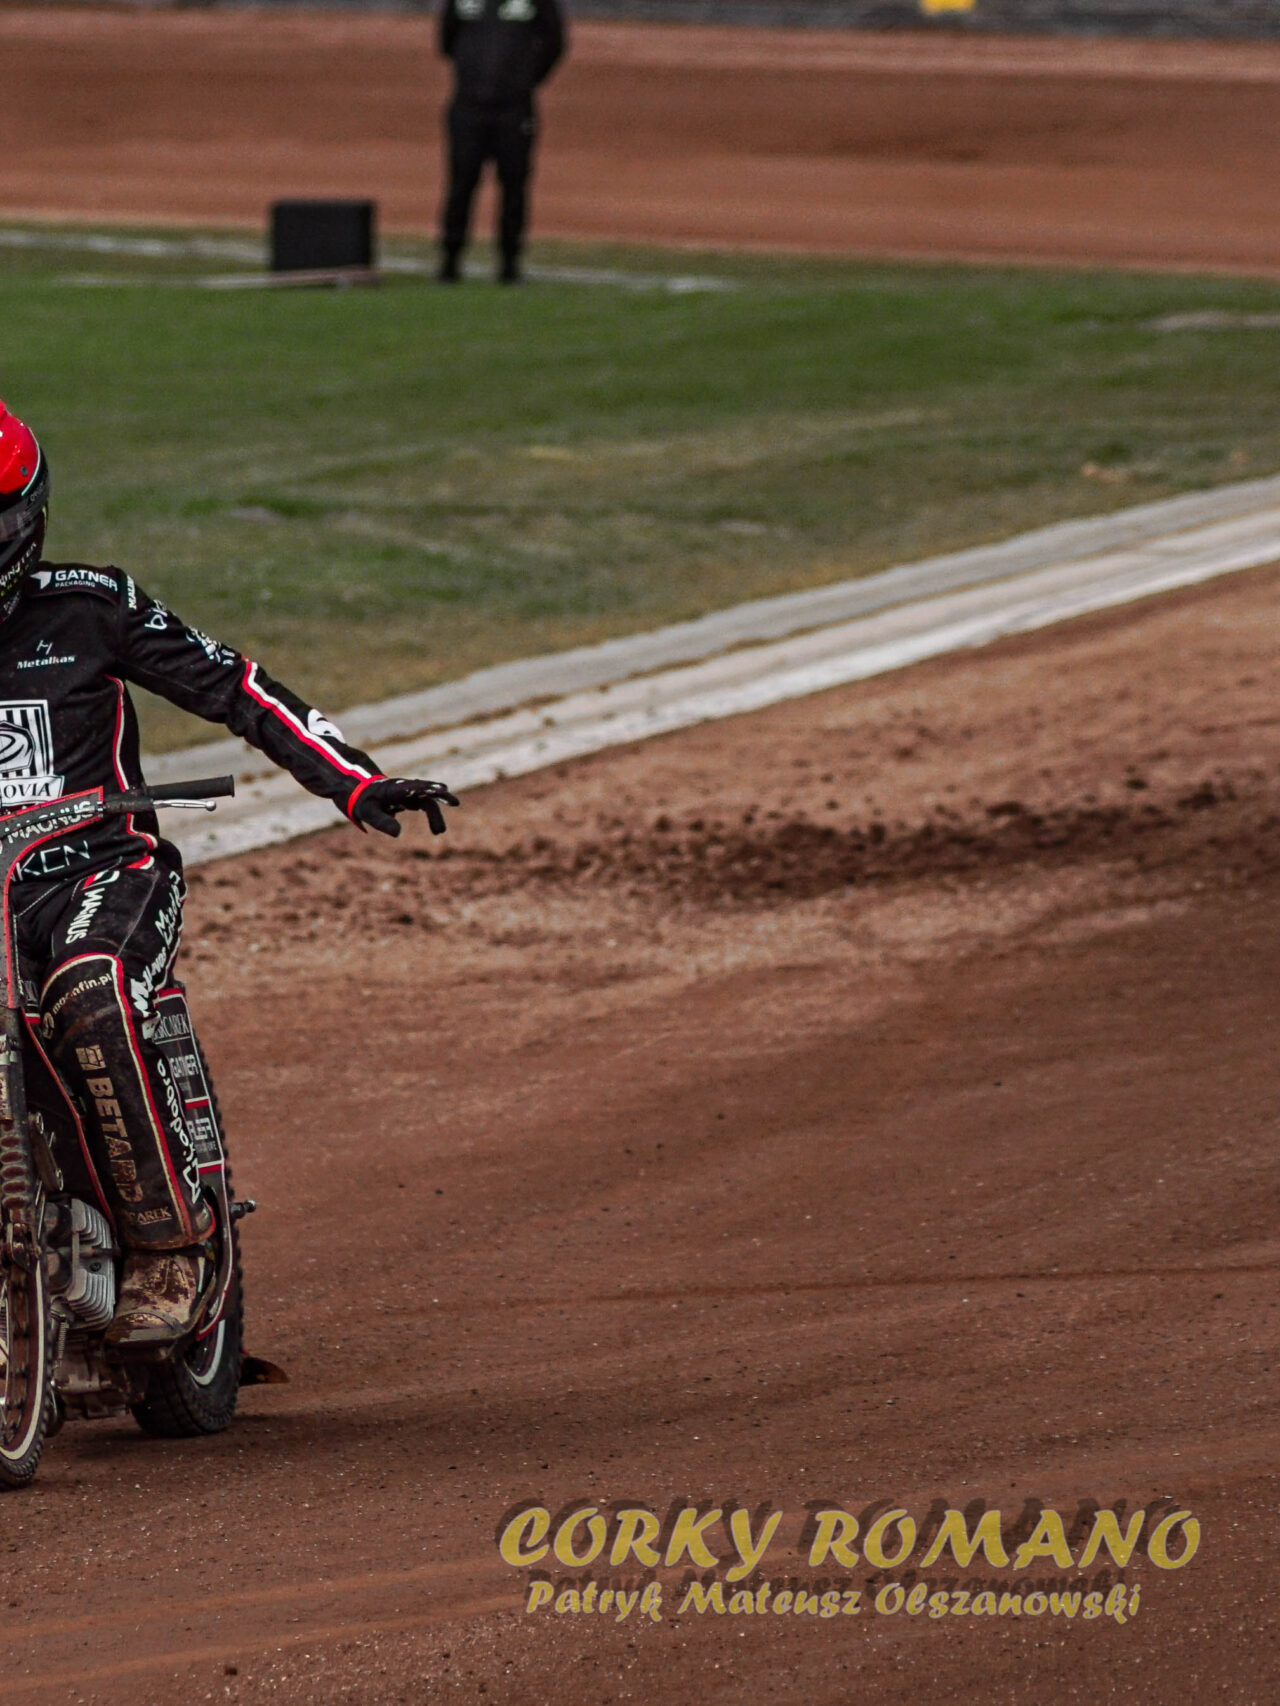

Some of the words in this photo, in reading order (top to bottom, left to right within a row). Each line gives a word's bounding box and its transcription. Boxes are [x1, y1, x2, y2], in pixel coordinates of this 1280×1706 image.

[55, 569, 118, 592] GATNER
[17, 654, 76, 670] Metalkas
[86, 1077, 144, 1203] BETARD
